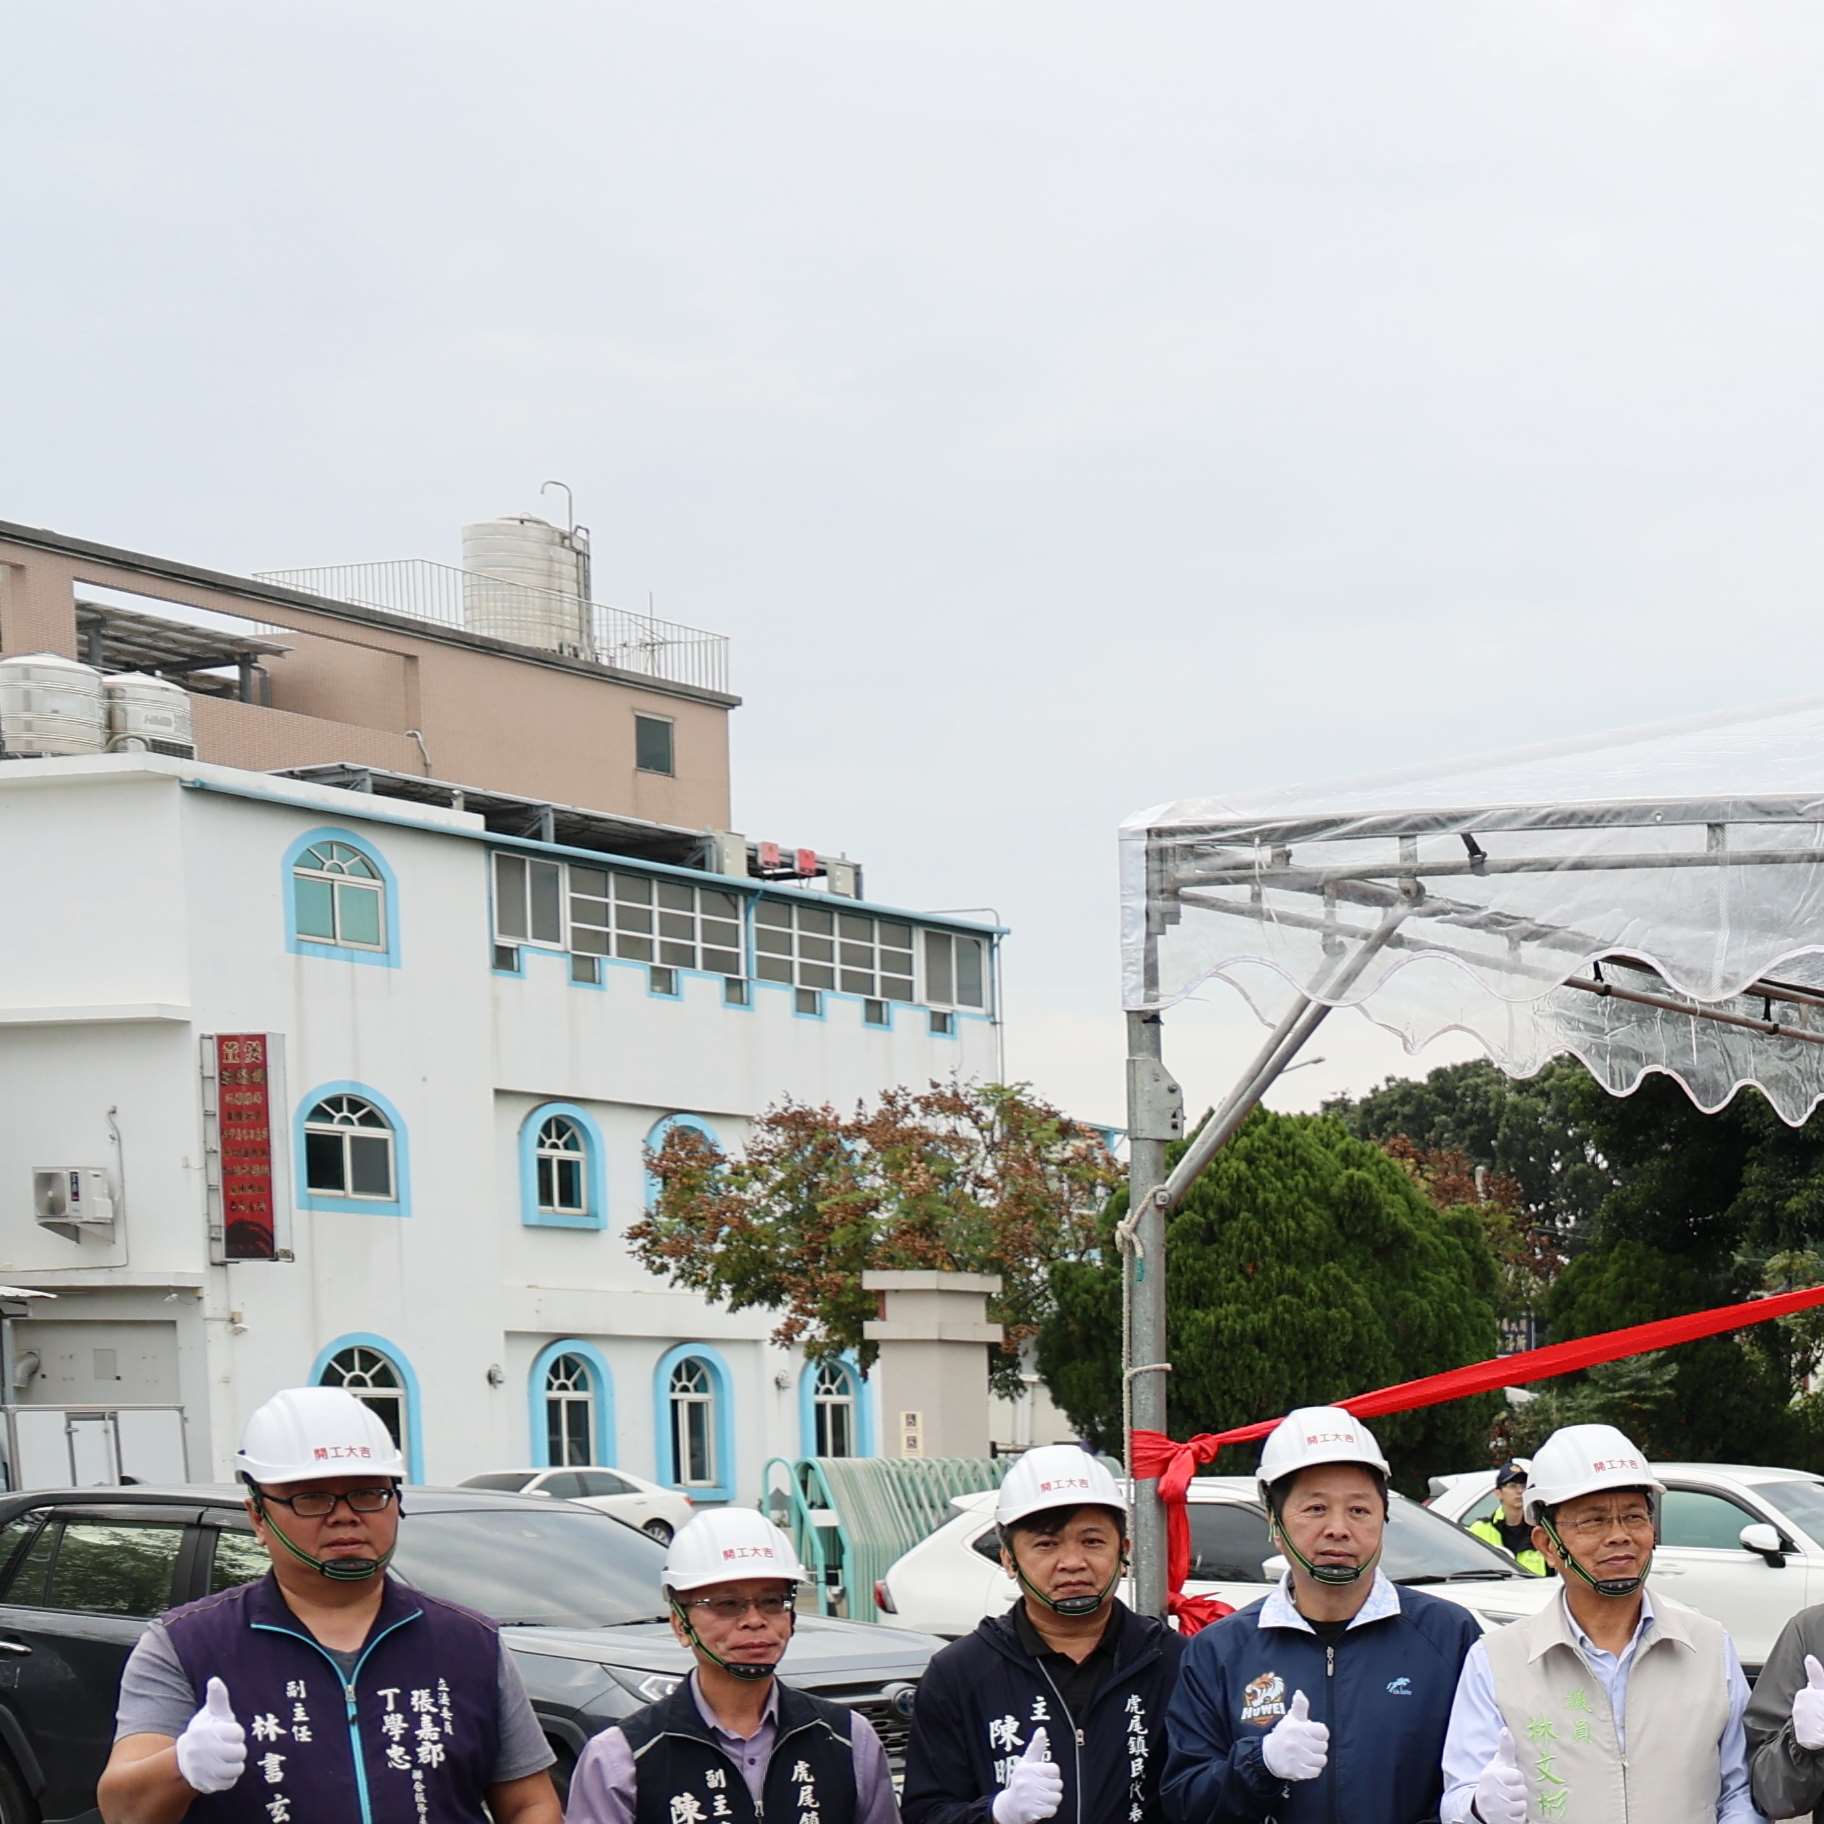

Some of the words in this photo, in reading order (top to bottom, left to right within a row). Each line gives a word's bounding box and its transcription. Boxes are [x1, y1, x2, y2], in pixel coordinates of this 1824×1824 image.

[286, 1679, 312, 1742] 副主任
[376, 1687, 412, 1770] 丁學忠
[410, 1688, 446, 1768] 張嘉郡
[251, 1713, 291, 1824] 林書玄
